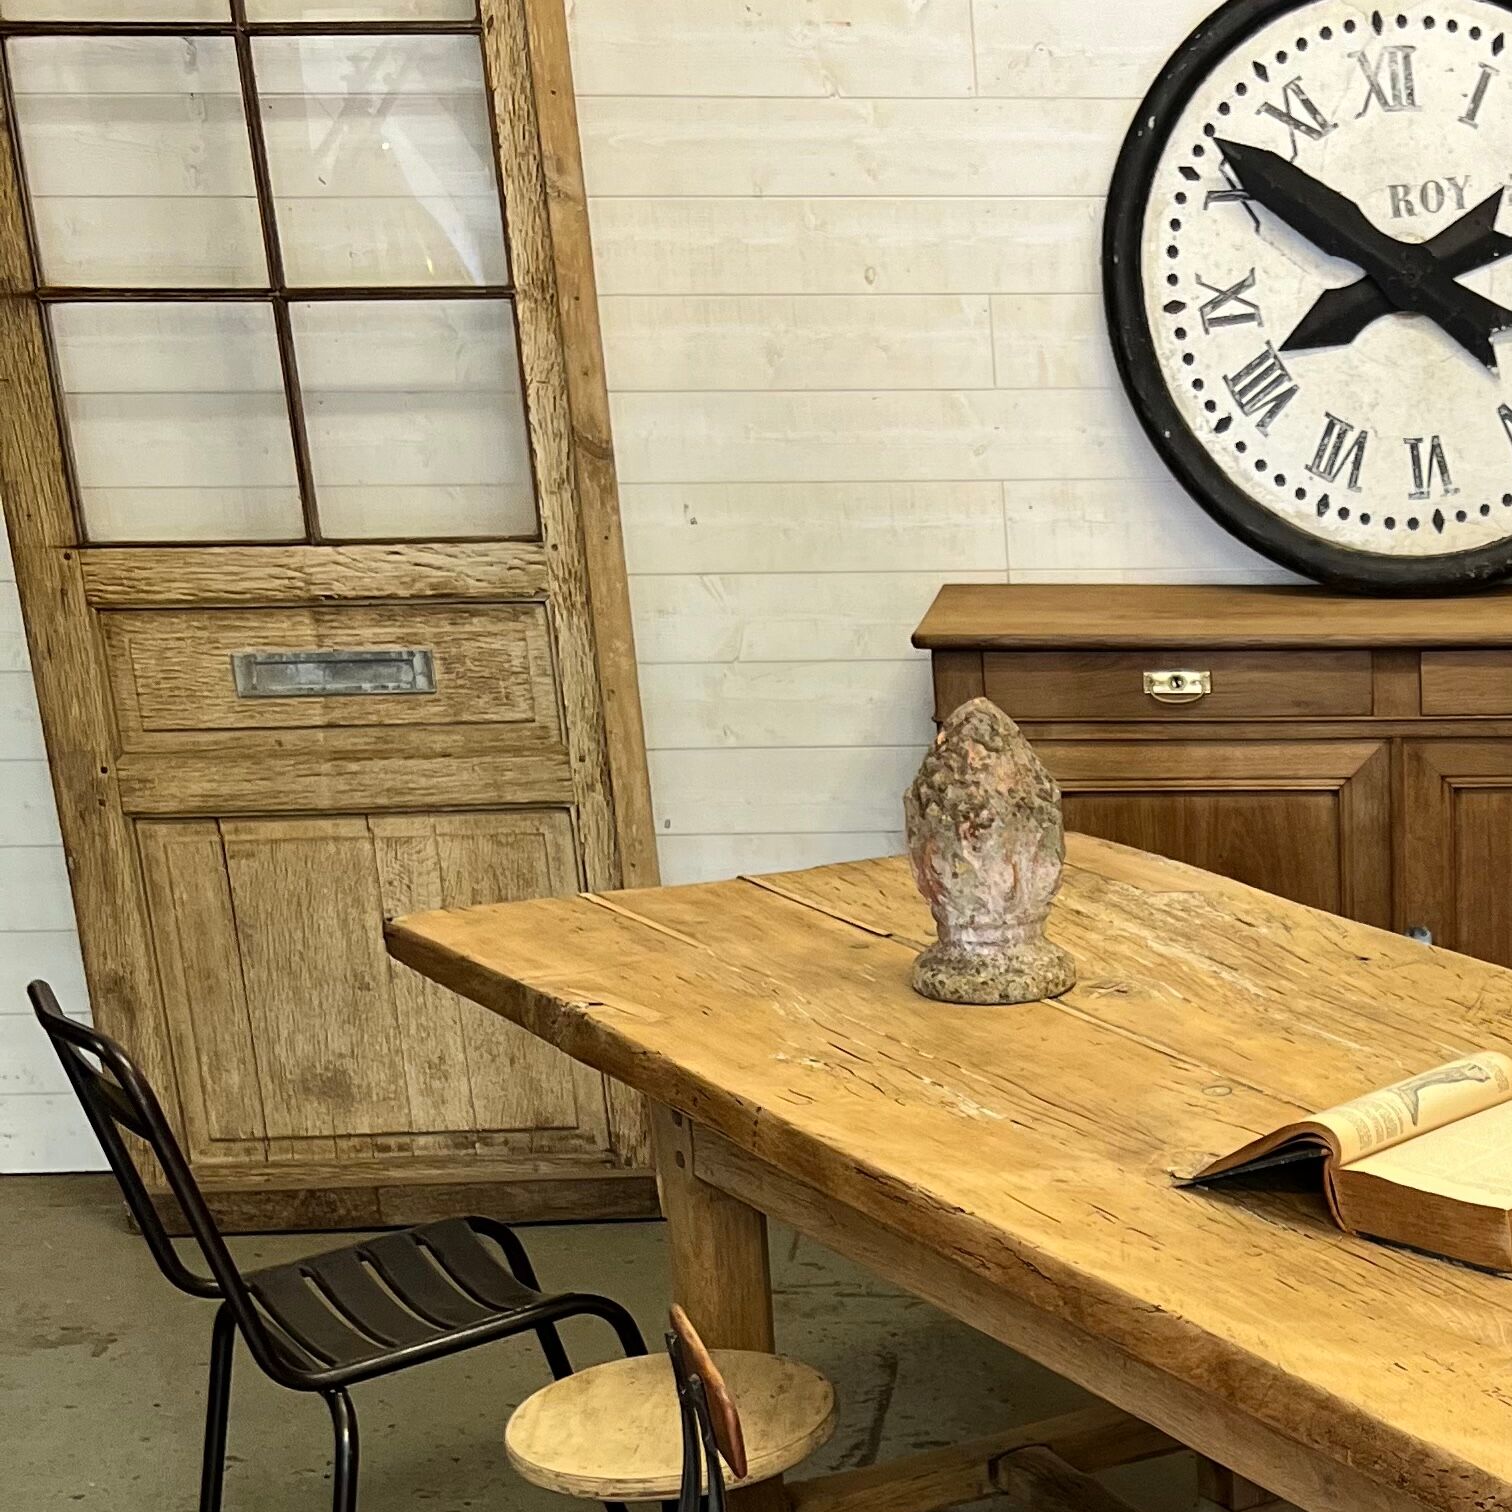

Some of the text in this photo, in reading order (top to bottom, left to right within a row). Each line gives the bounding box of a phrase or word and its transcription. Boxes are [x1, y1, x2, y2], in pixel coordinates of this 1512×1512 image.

[1349, 45, 1423, 120] XII
[1458, 62, 1499, 129] I
[1255, 75, 1339, 163] XI
[1387, 174, 1471, 219] ROY
[1195, 267, 1264, 335] IX
[1222, 339, 1300, 438] VIII
[1304, 411, 1369, 494] VII
[1403, 435, 1461, 500] VI
